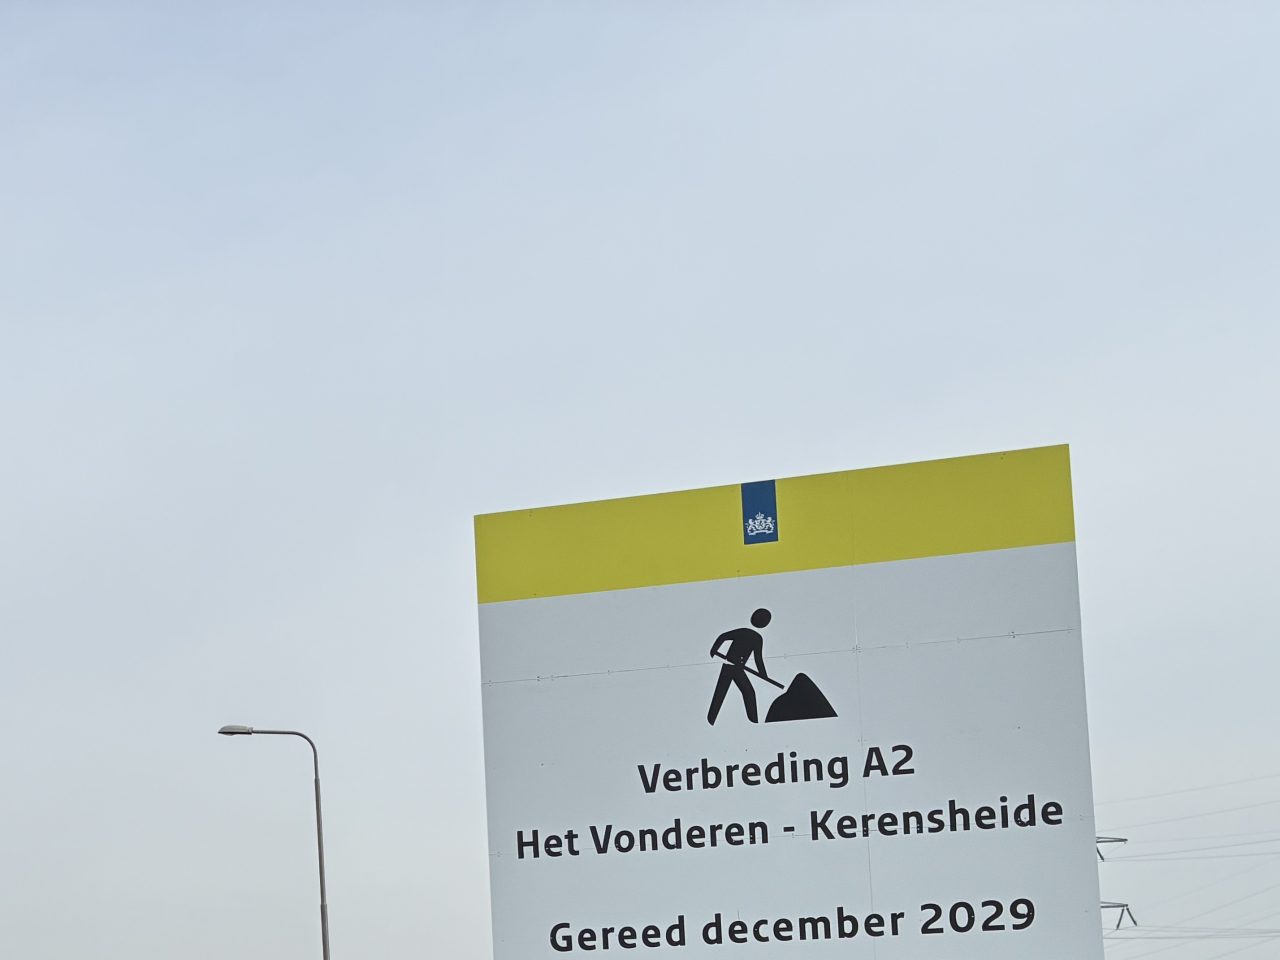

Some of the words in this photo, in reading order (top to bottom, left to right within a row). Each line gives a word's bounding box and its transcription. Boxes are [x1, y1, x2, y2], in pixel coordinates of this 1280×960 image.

[637, 751, 850, 794] Verbreding
[862, 744, 916, 778] A2
[516, 829, 580, 860] Het
[589, 818, 769, 855] Vonderen
[810, 793, 1063, 842] Kerensheide
[549, 914, 686, 952] Gereed
[702, 906, 905, 945] december
[920, 898, 1036, 935] 2029
